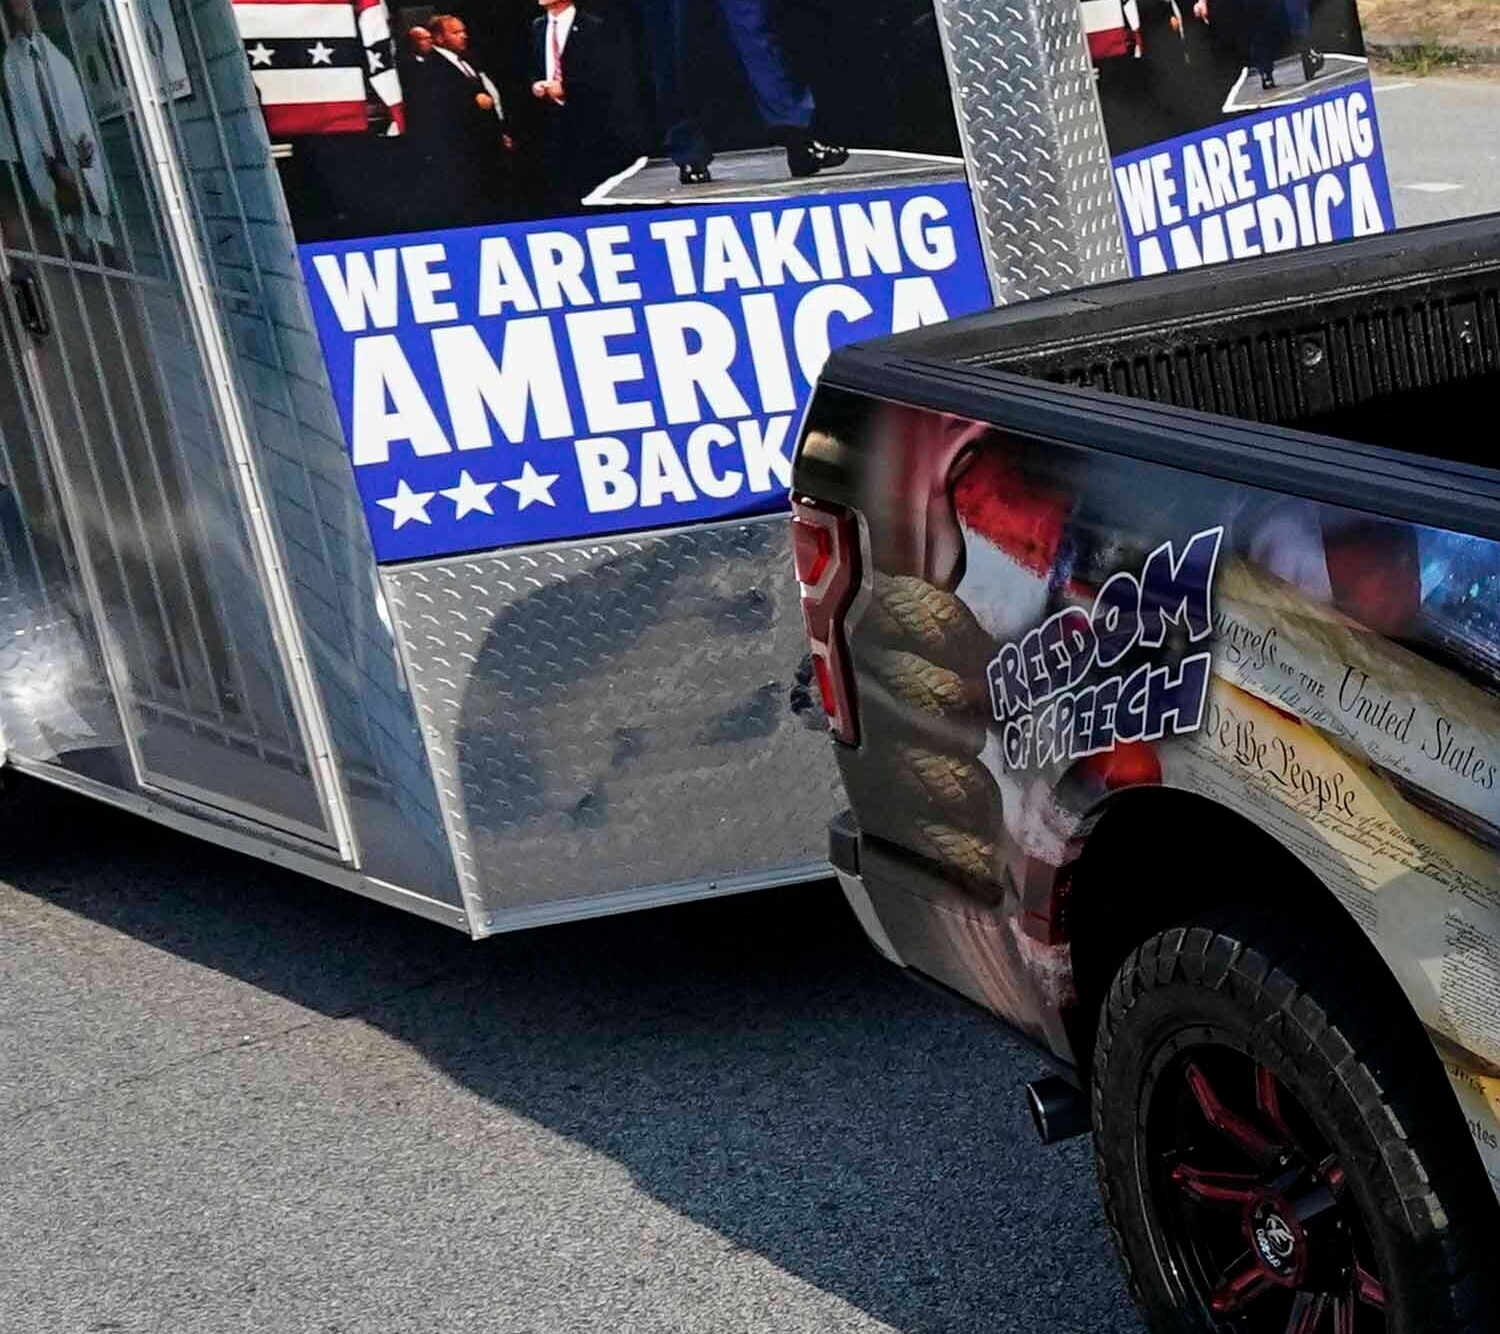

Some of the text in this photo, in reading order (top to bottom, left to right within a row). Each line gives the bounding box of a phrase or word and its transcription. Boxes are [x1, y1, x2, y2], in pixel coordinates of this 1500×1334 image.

[1114, 91, 1374, 237] WE ARE TAKING
[313, 196, 957, 333] WE ARE TAKING
[575, 418, 794, 515] BACK
[986, 526, 1225, 722] FREEDOM
[1003, 713, 1034, 769] OF
[1035, 651, 1211, 769] SPEECH
[1338, 666, 1416, 745] United
[1421, 716, 1498, 789] States
[1265, 736, 1357, 817] People
